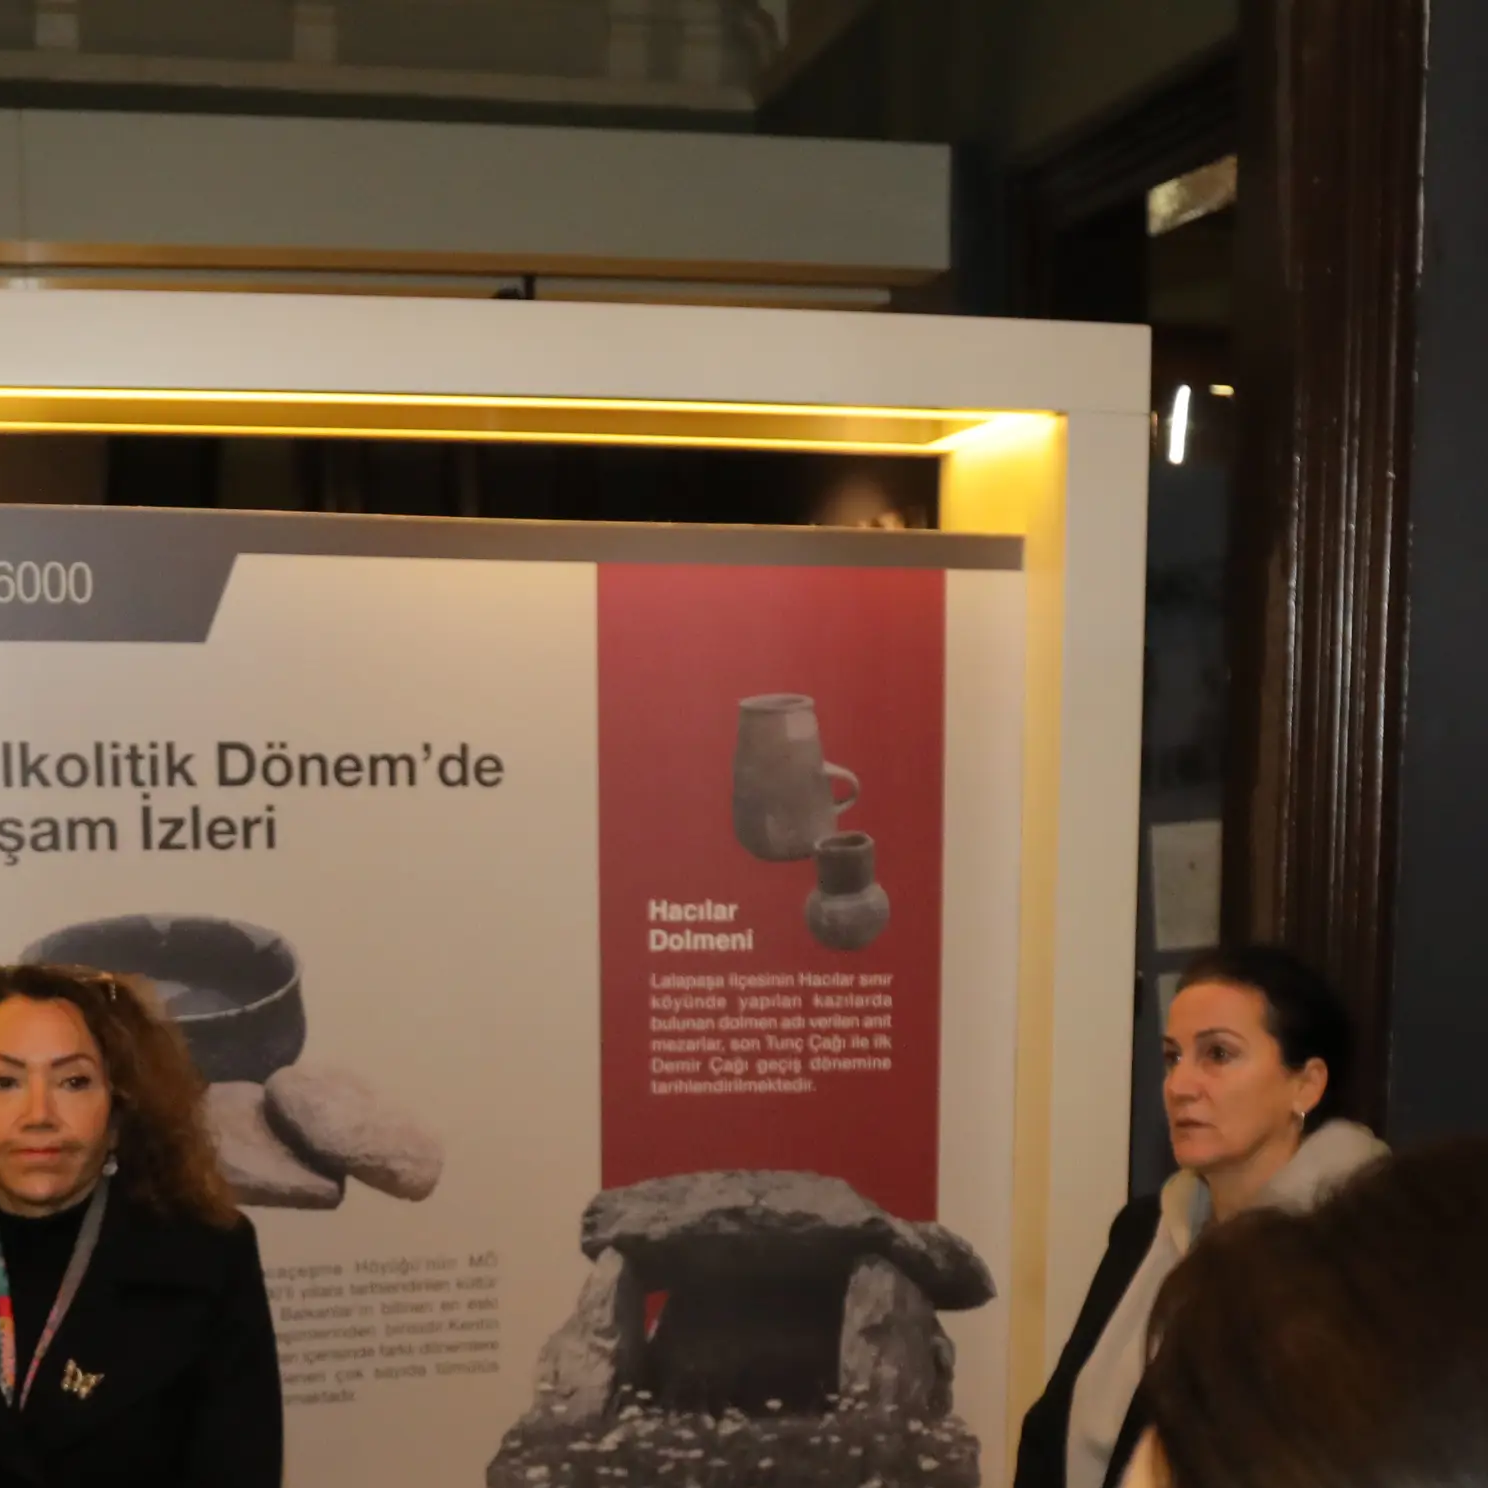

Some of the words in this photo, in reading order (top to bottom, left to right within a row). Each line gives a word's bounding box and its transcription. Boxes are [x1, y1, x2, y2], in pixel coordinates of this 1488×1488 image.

[141, 792, 277, 850] İzleri
[649, 898, 739, 921] Hacılar
[649, 929, 754, 951] Dolmeni
[650, 973, 724, 991] Lalapaşa
[729, 973, 795, 991] ilçesinin
[799, 972, 854, 988] Hacılar
[651, 995, 727, 1012] köyünde
[739, 994, 802, 1011] yapılan
[814, 994, 893, 1008] kazılarda
[650, 1016, 715, 1032] bulunan
[719, 1015, 778, 1031] dolmen
[809, 1014, 860, 1029] verilen
[730, 1038, 760, 1051] son
[765, 1034, 804, 1052] Tunç
[808, 1033, 846, 1053] Çağı
[651, 1058, 702, 1073] Demir
[709, 1056, 749, 1075] Çağı
[809, 1055, 892, 1071] dönemine
